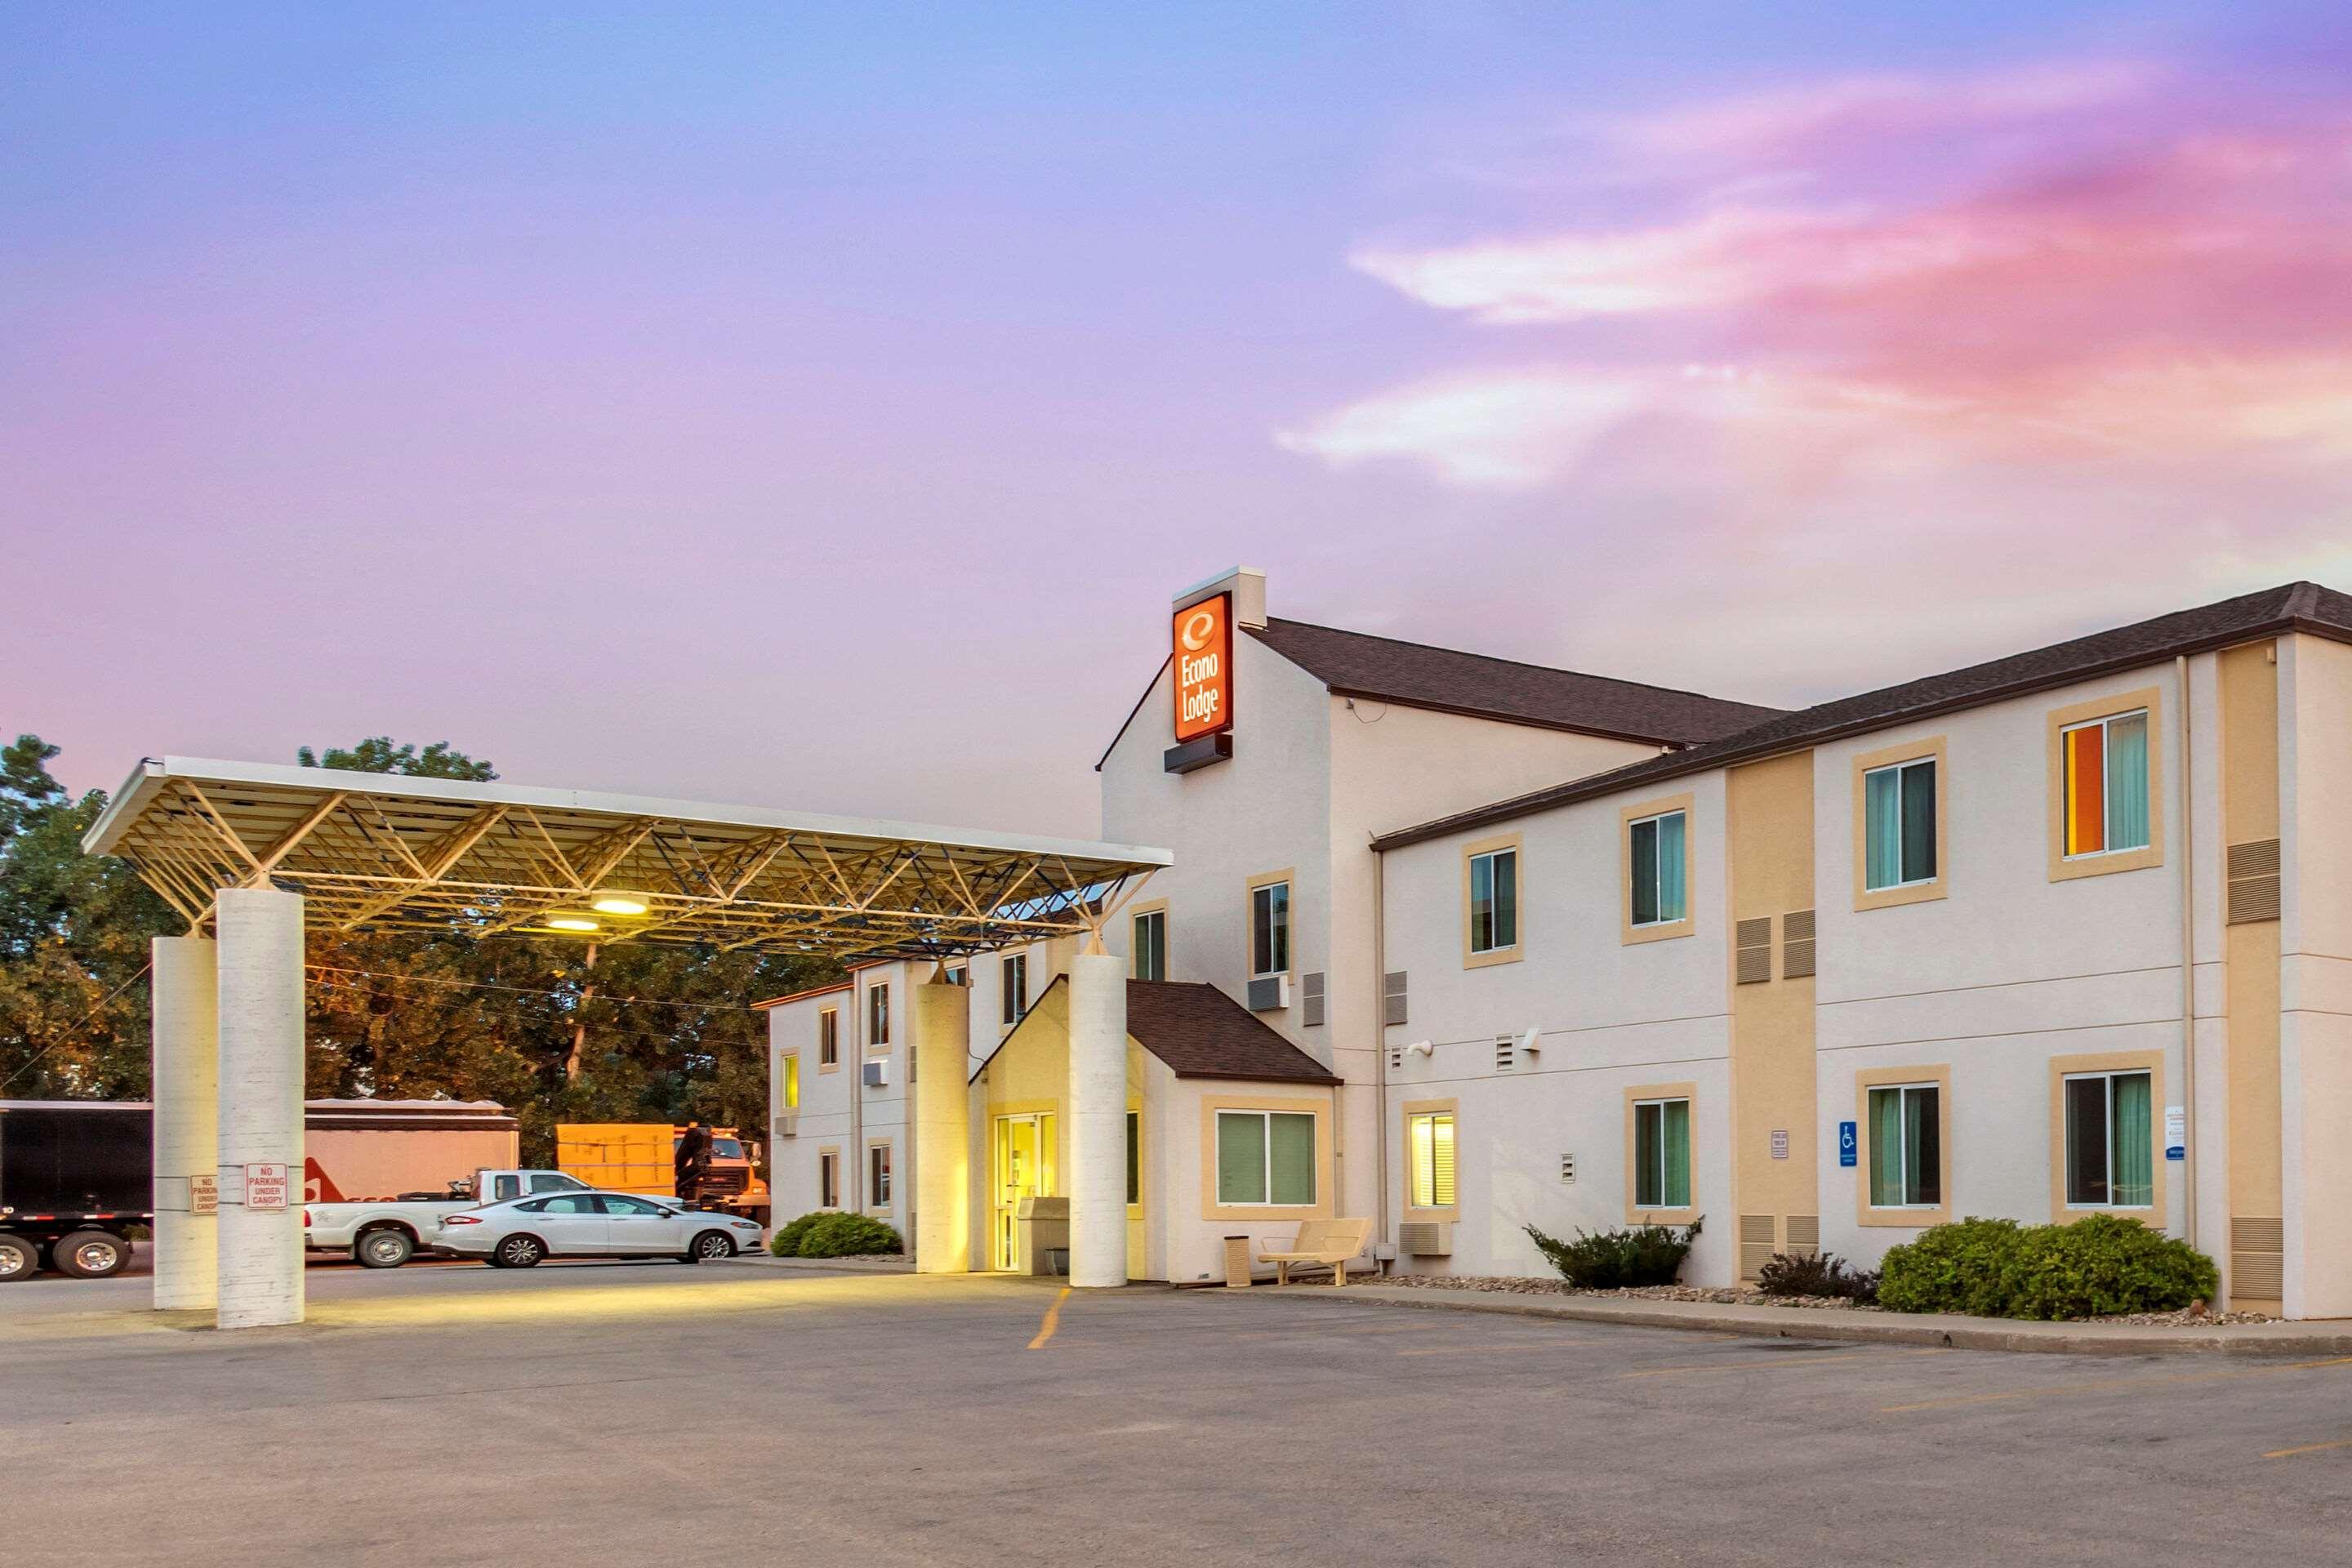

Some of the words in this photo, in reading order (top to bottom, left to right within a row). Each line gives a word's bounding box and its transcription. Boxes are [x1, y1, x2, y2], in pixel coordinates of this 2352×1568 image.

[1182, 653, 1218, 688] Econo
[1182, 684, 1218, 723] Lodge
[261, 1167, 273, 1176] NO
[202, 1178, 212, 1186] NO
[248, 1177, 285, 1186] PARKING
[253, 1196, 283, 1204] CANOPY
